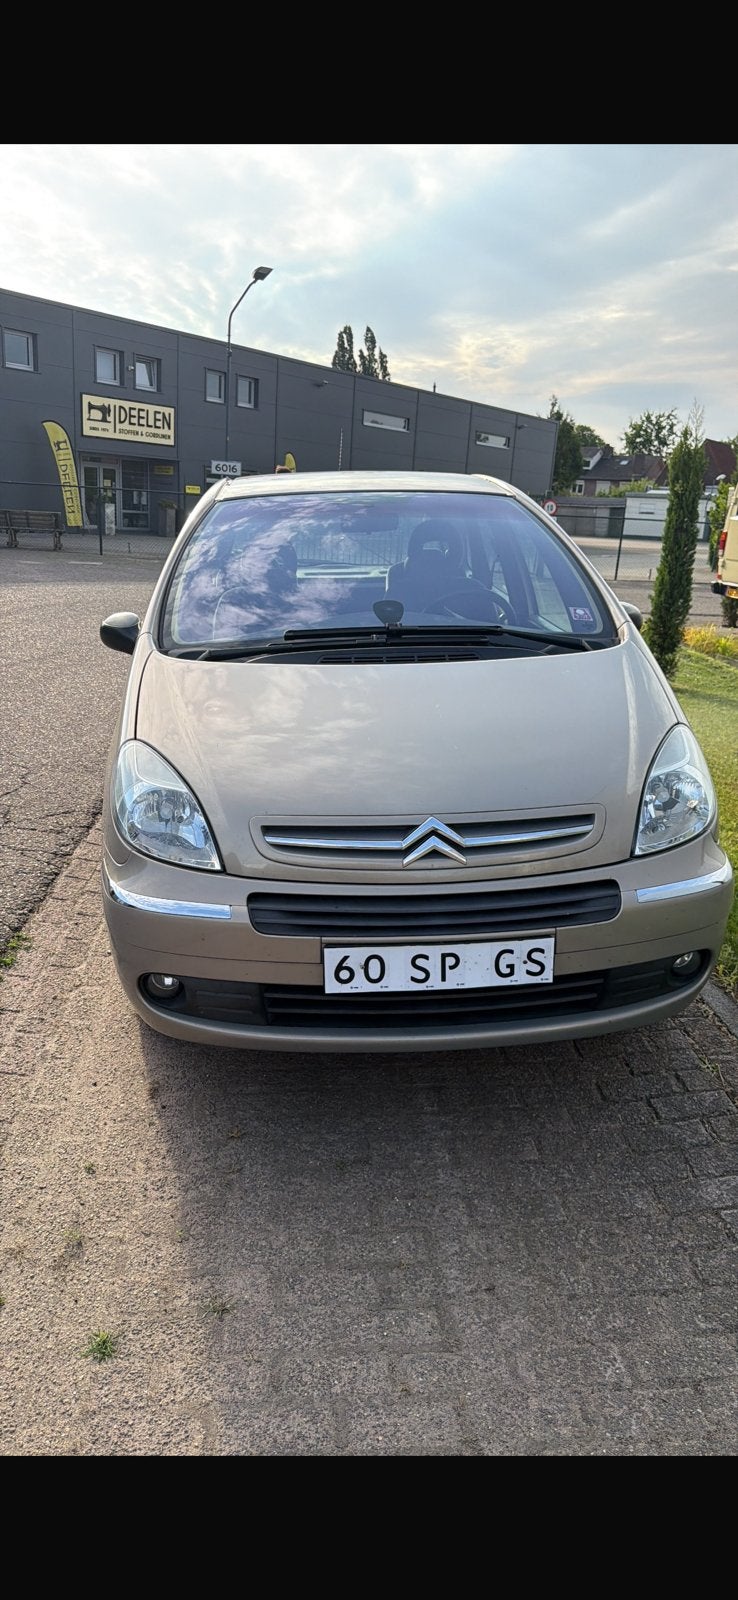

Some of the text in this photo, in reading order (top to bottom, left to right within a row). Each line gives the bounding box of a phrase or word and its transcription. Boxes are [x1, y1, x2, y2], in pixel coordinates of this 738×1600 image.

[118, 405, 171, 430] DEELEN
[118, 428, 139, 436] STOFFEN
[215, 463, 238, 473] 6016
[334, 947, 546, 984] 60 SP GS
